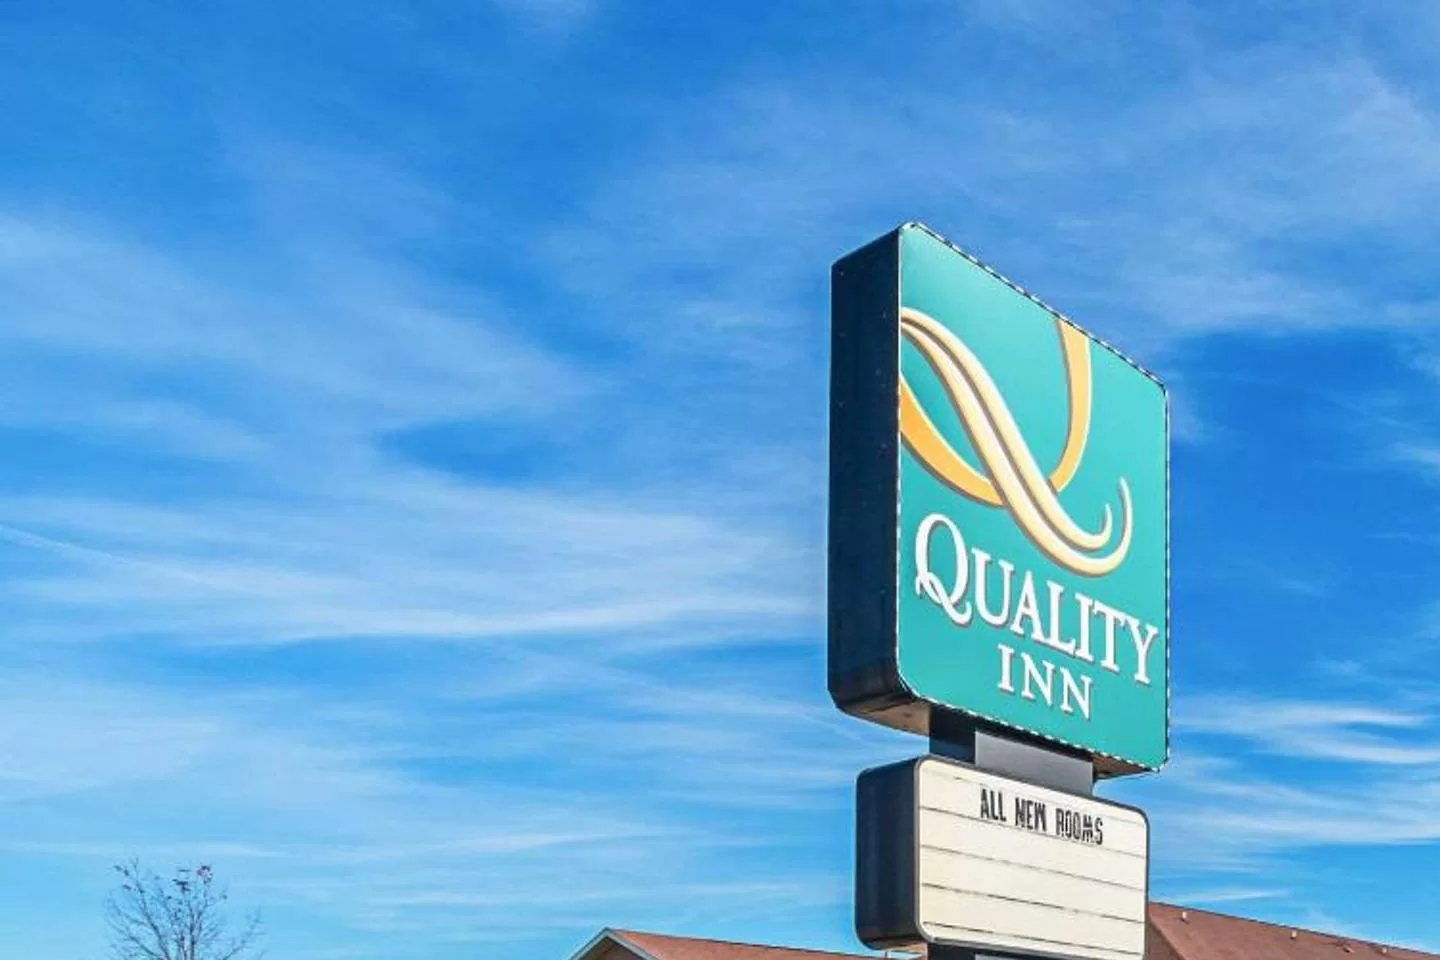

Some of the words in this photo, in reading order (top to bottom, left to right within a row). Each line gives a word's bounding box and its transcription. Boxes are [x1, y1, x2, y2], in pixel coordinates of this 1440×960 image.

[915, 513, 1159, 684] QUALITY
[997, 643, 1093, 719] INN
[980, 788, 1007, 822] ALL
[1015, 797, 1047, 832] NEW
[1055, 808, 1104, 845] ROOMS
